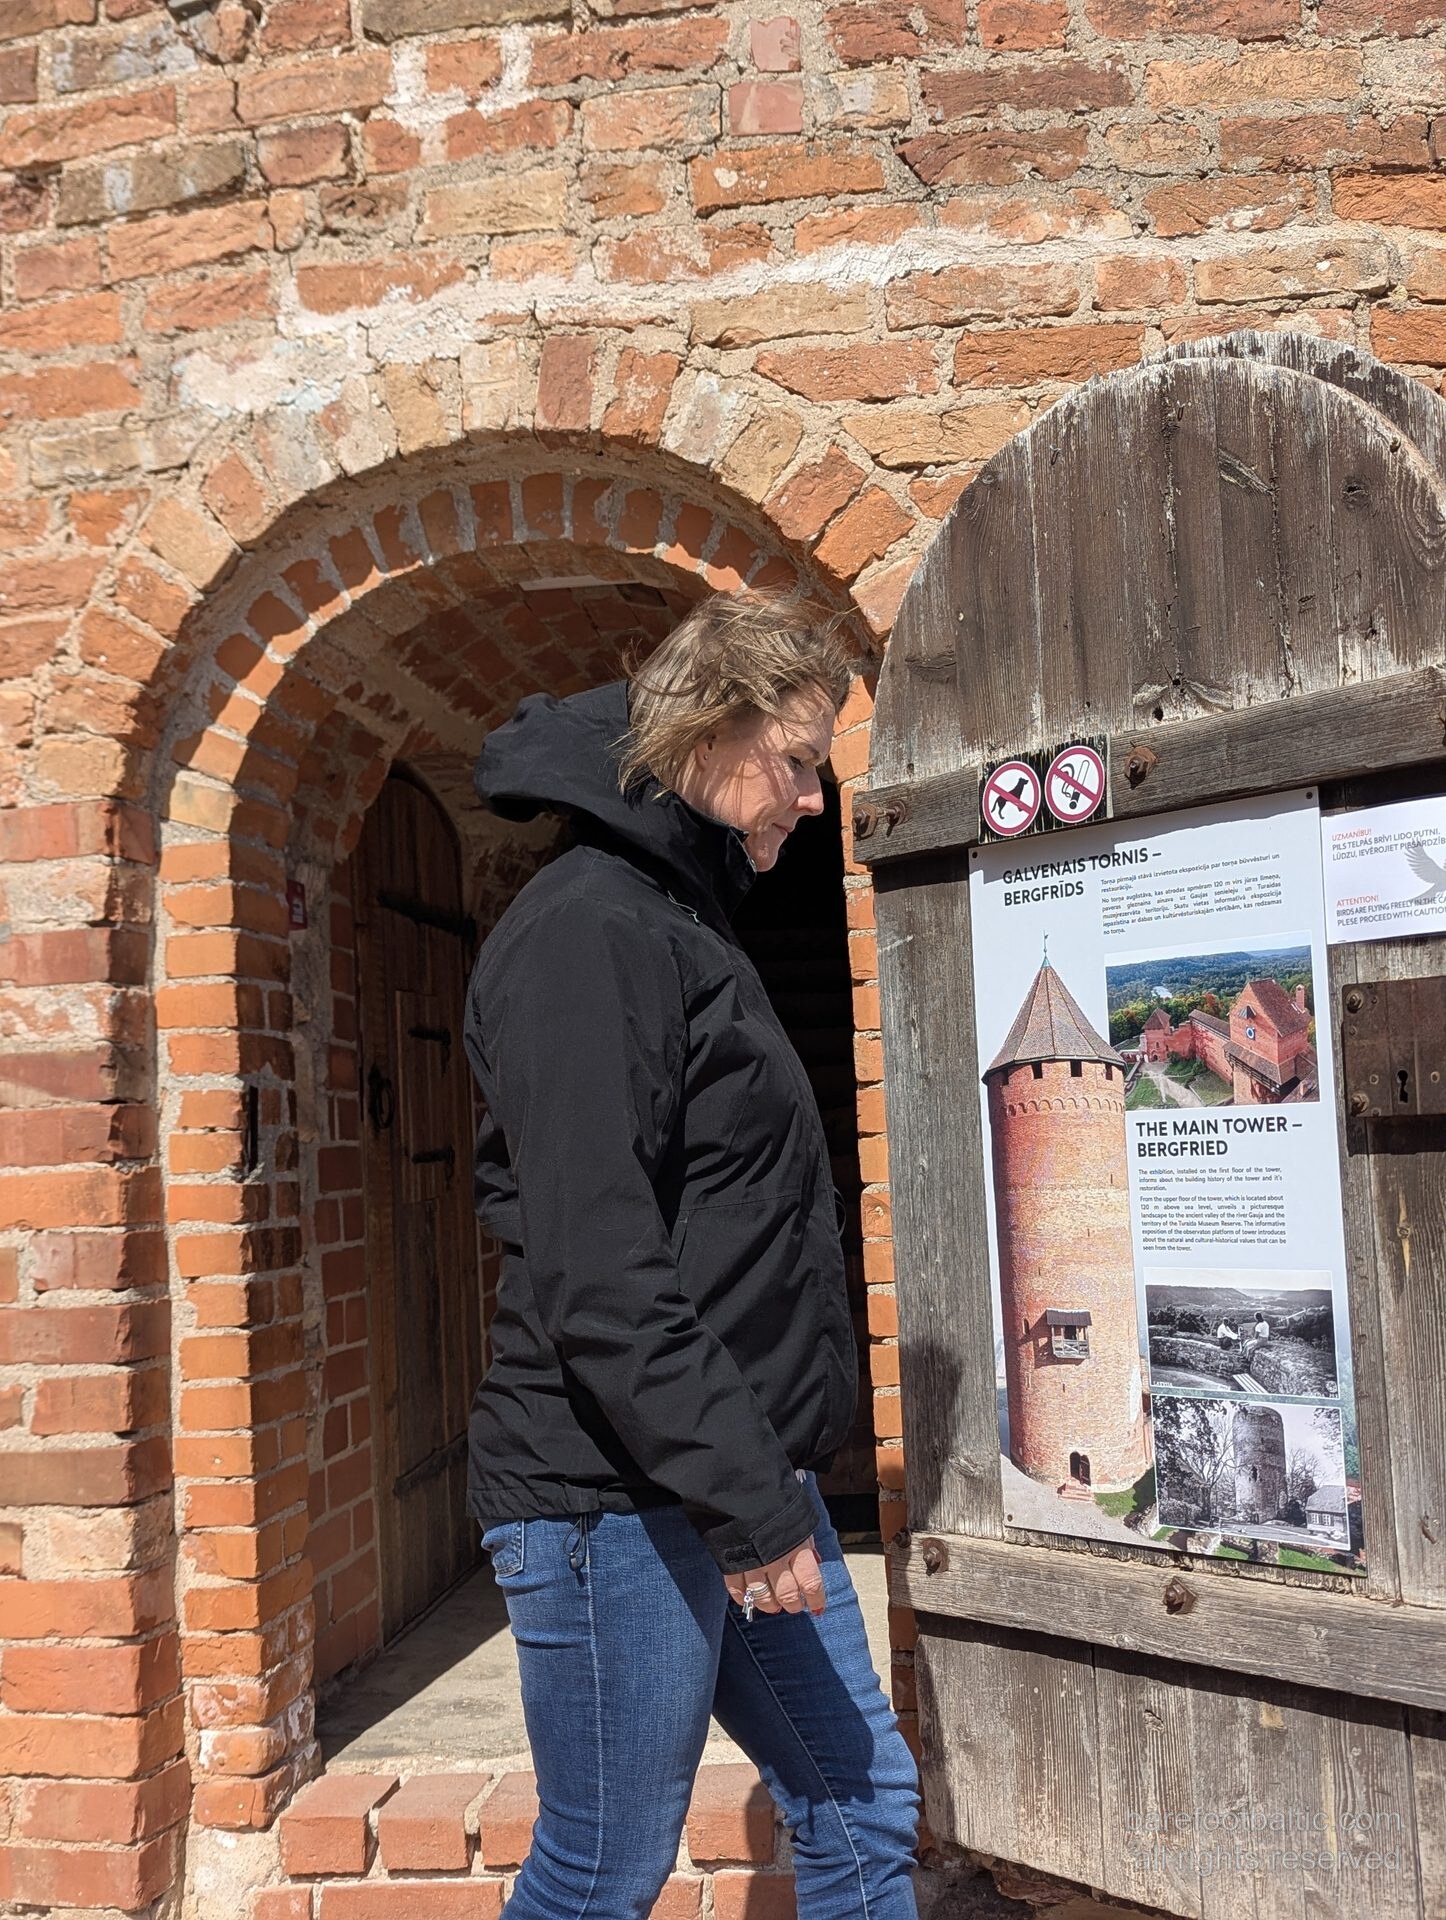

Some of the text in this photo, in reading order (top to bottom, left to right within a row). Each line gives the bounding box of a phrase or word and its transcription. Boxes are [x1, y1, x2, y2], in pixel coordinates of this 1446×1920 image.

[1332, 828, 1371, 841] UZMANĪBU!
[1393, 831, 1412, 841] LIDO
[1414, 828, 1441, 837] PUTNI.
[1002, 848, 1148, 884] GALVENAIS TORNIS
[1004, 880, 1084, 906] BERGFRĪDS
[1337, 895, 1379, 907] ATTENTION!
[1336, 908, 1354, 917] BIRDS
[1355, 906, 1367, 914] ARE
[1368, 903, 1390, 912] FLYING
[1390, 899, 1412, 909] FREELY
[1422, 897, 1437, 905] THE
[1360, 913, 1392, 923] PROCEED
[1392, 910, 1412, 918] WITH
[1136, 1116, 1288, 1137] THE MAIN TOWER
[1137, 1140, 1228, 1158] BERGFRIED
